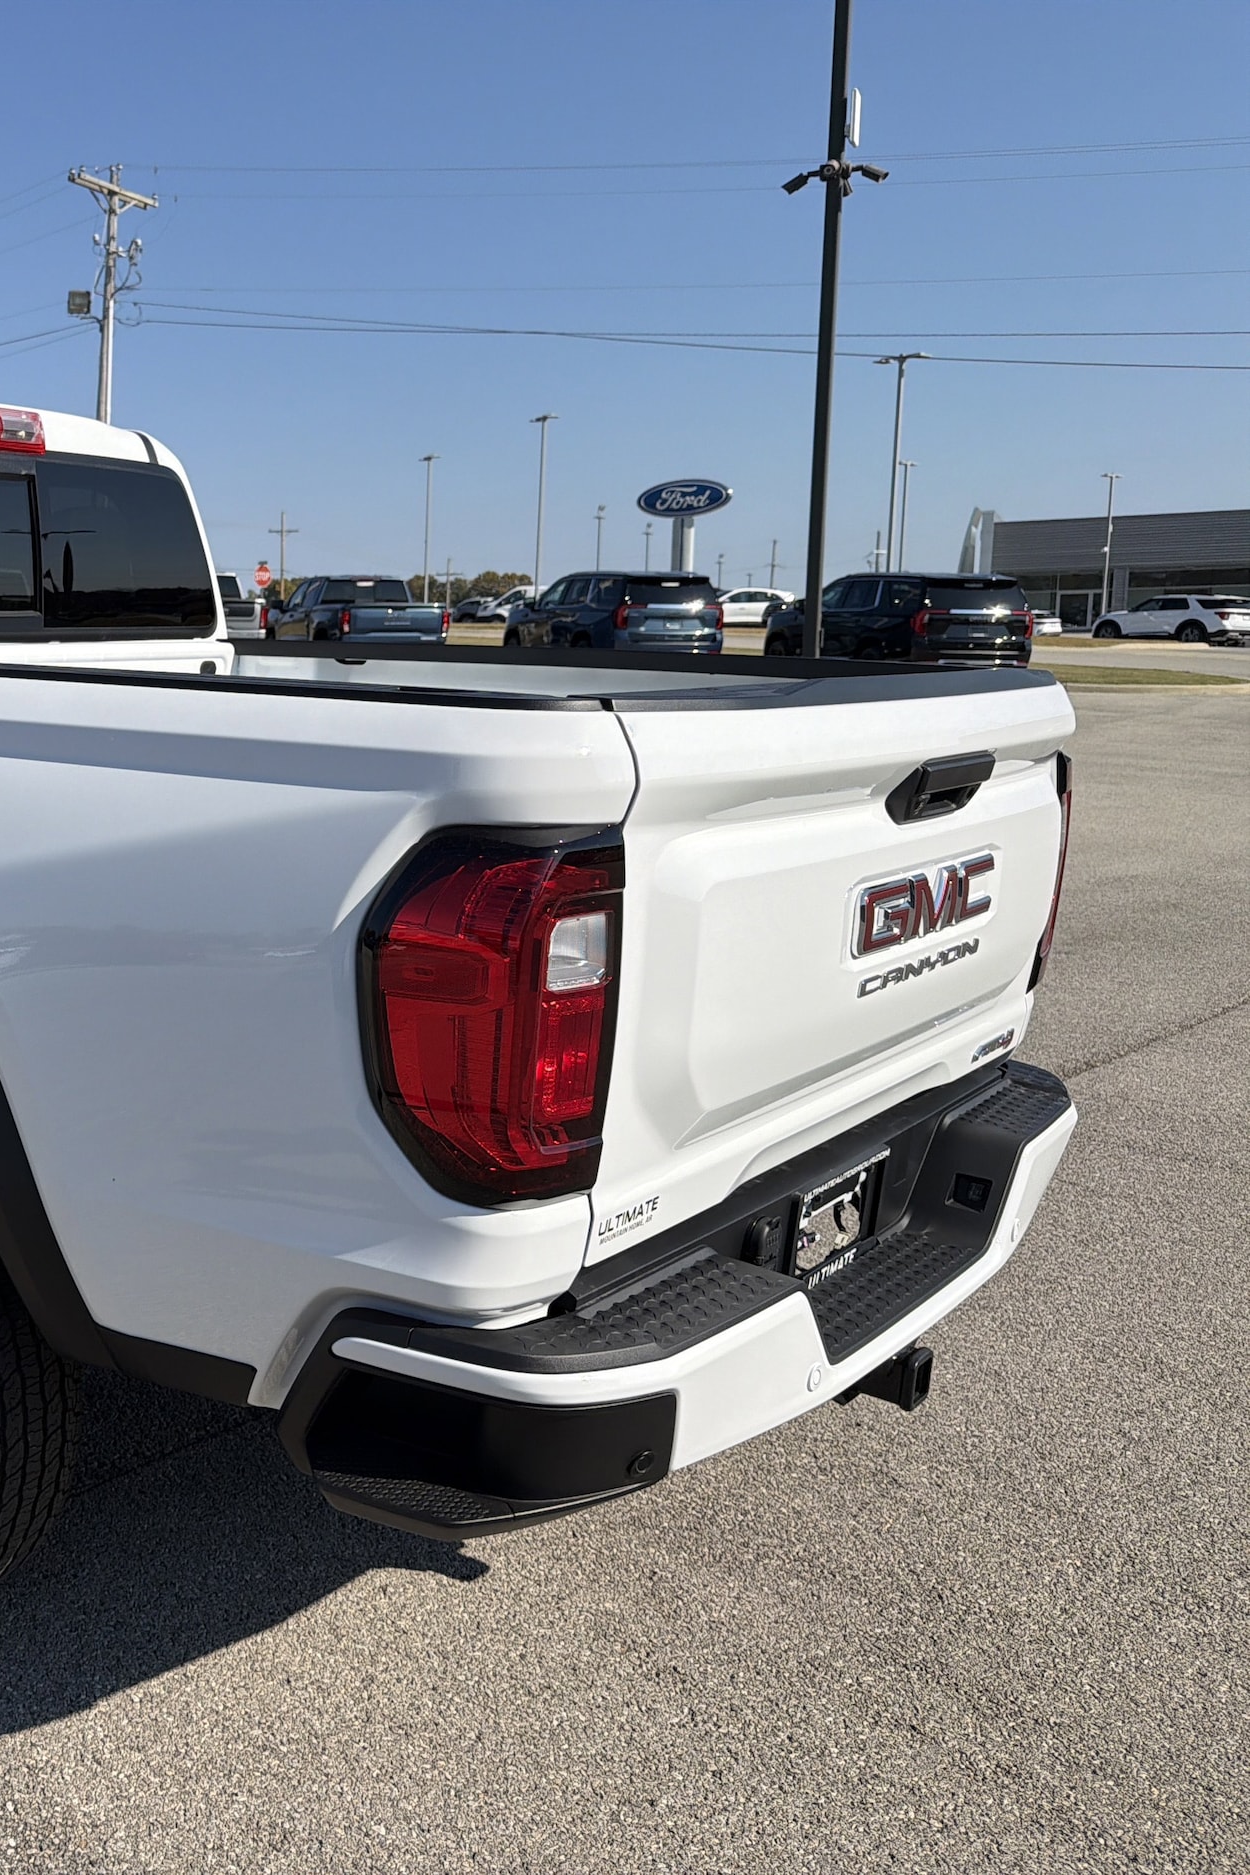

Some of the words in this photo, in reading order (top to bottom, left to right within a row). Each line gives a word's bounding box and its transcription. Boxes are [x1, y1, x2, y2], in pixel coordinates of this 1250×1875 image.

[656, 486, 711, 511] Ford
[254, 571, 270, 580] STOP
[851, 852, 995, 959] GMC
[856, 937, 980, 999] CANYON
[598, 1196, 659, 1236] ULTIMATE
[807, 1248, 857, 1290] ULTIMATE
